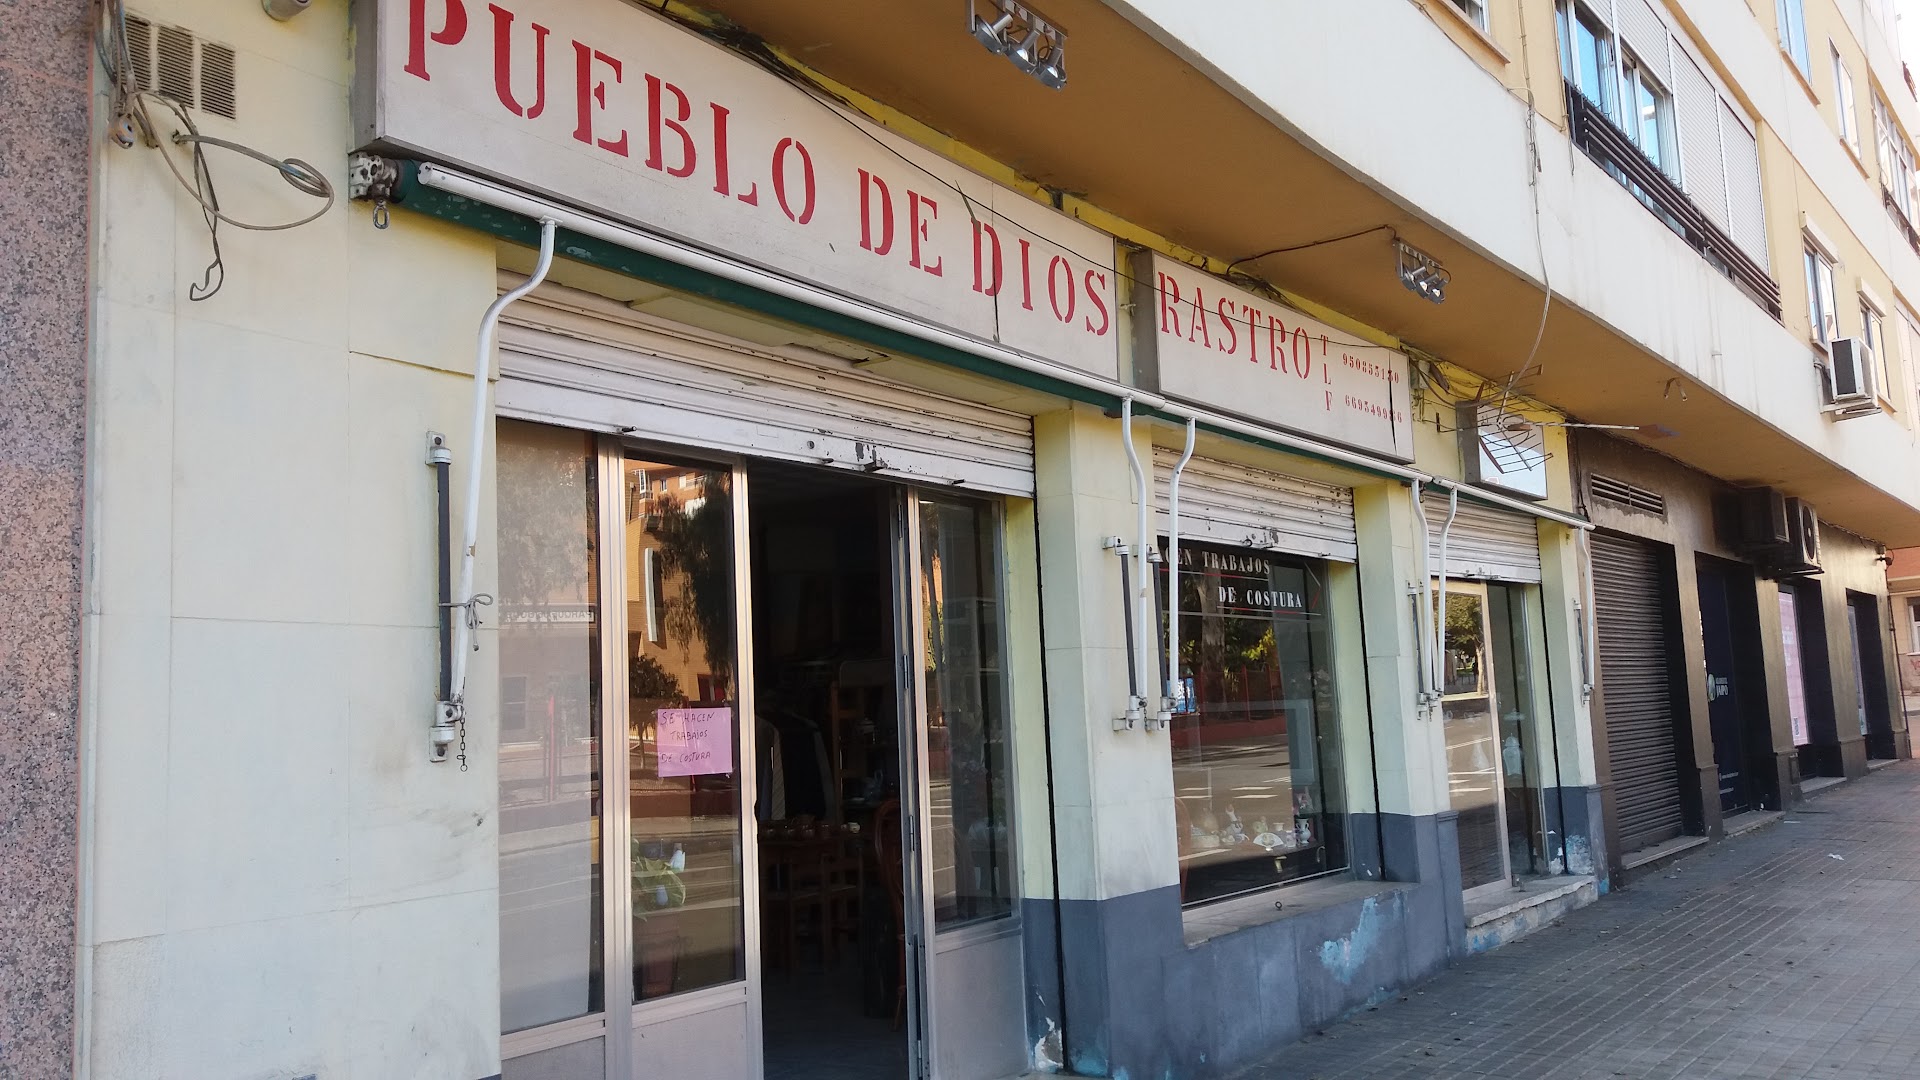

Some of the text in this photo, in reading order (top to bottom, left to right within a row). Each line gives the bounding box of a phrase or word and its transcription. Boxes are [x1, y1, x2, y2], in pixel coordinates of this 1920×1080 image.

[404, 0, 1109, 336] PUEBLO DE DIOS
[1158, 272, 1311, 380] RASTRO
[1202, 551, 1270, 575] TRABAJOS
[1218, 586, 1303, 608] DE COSTURA
[660, 711, 715, 726] SE HACEN
[679, 751, 711, 763] COSTURA
